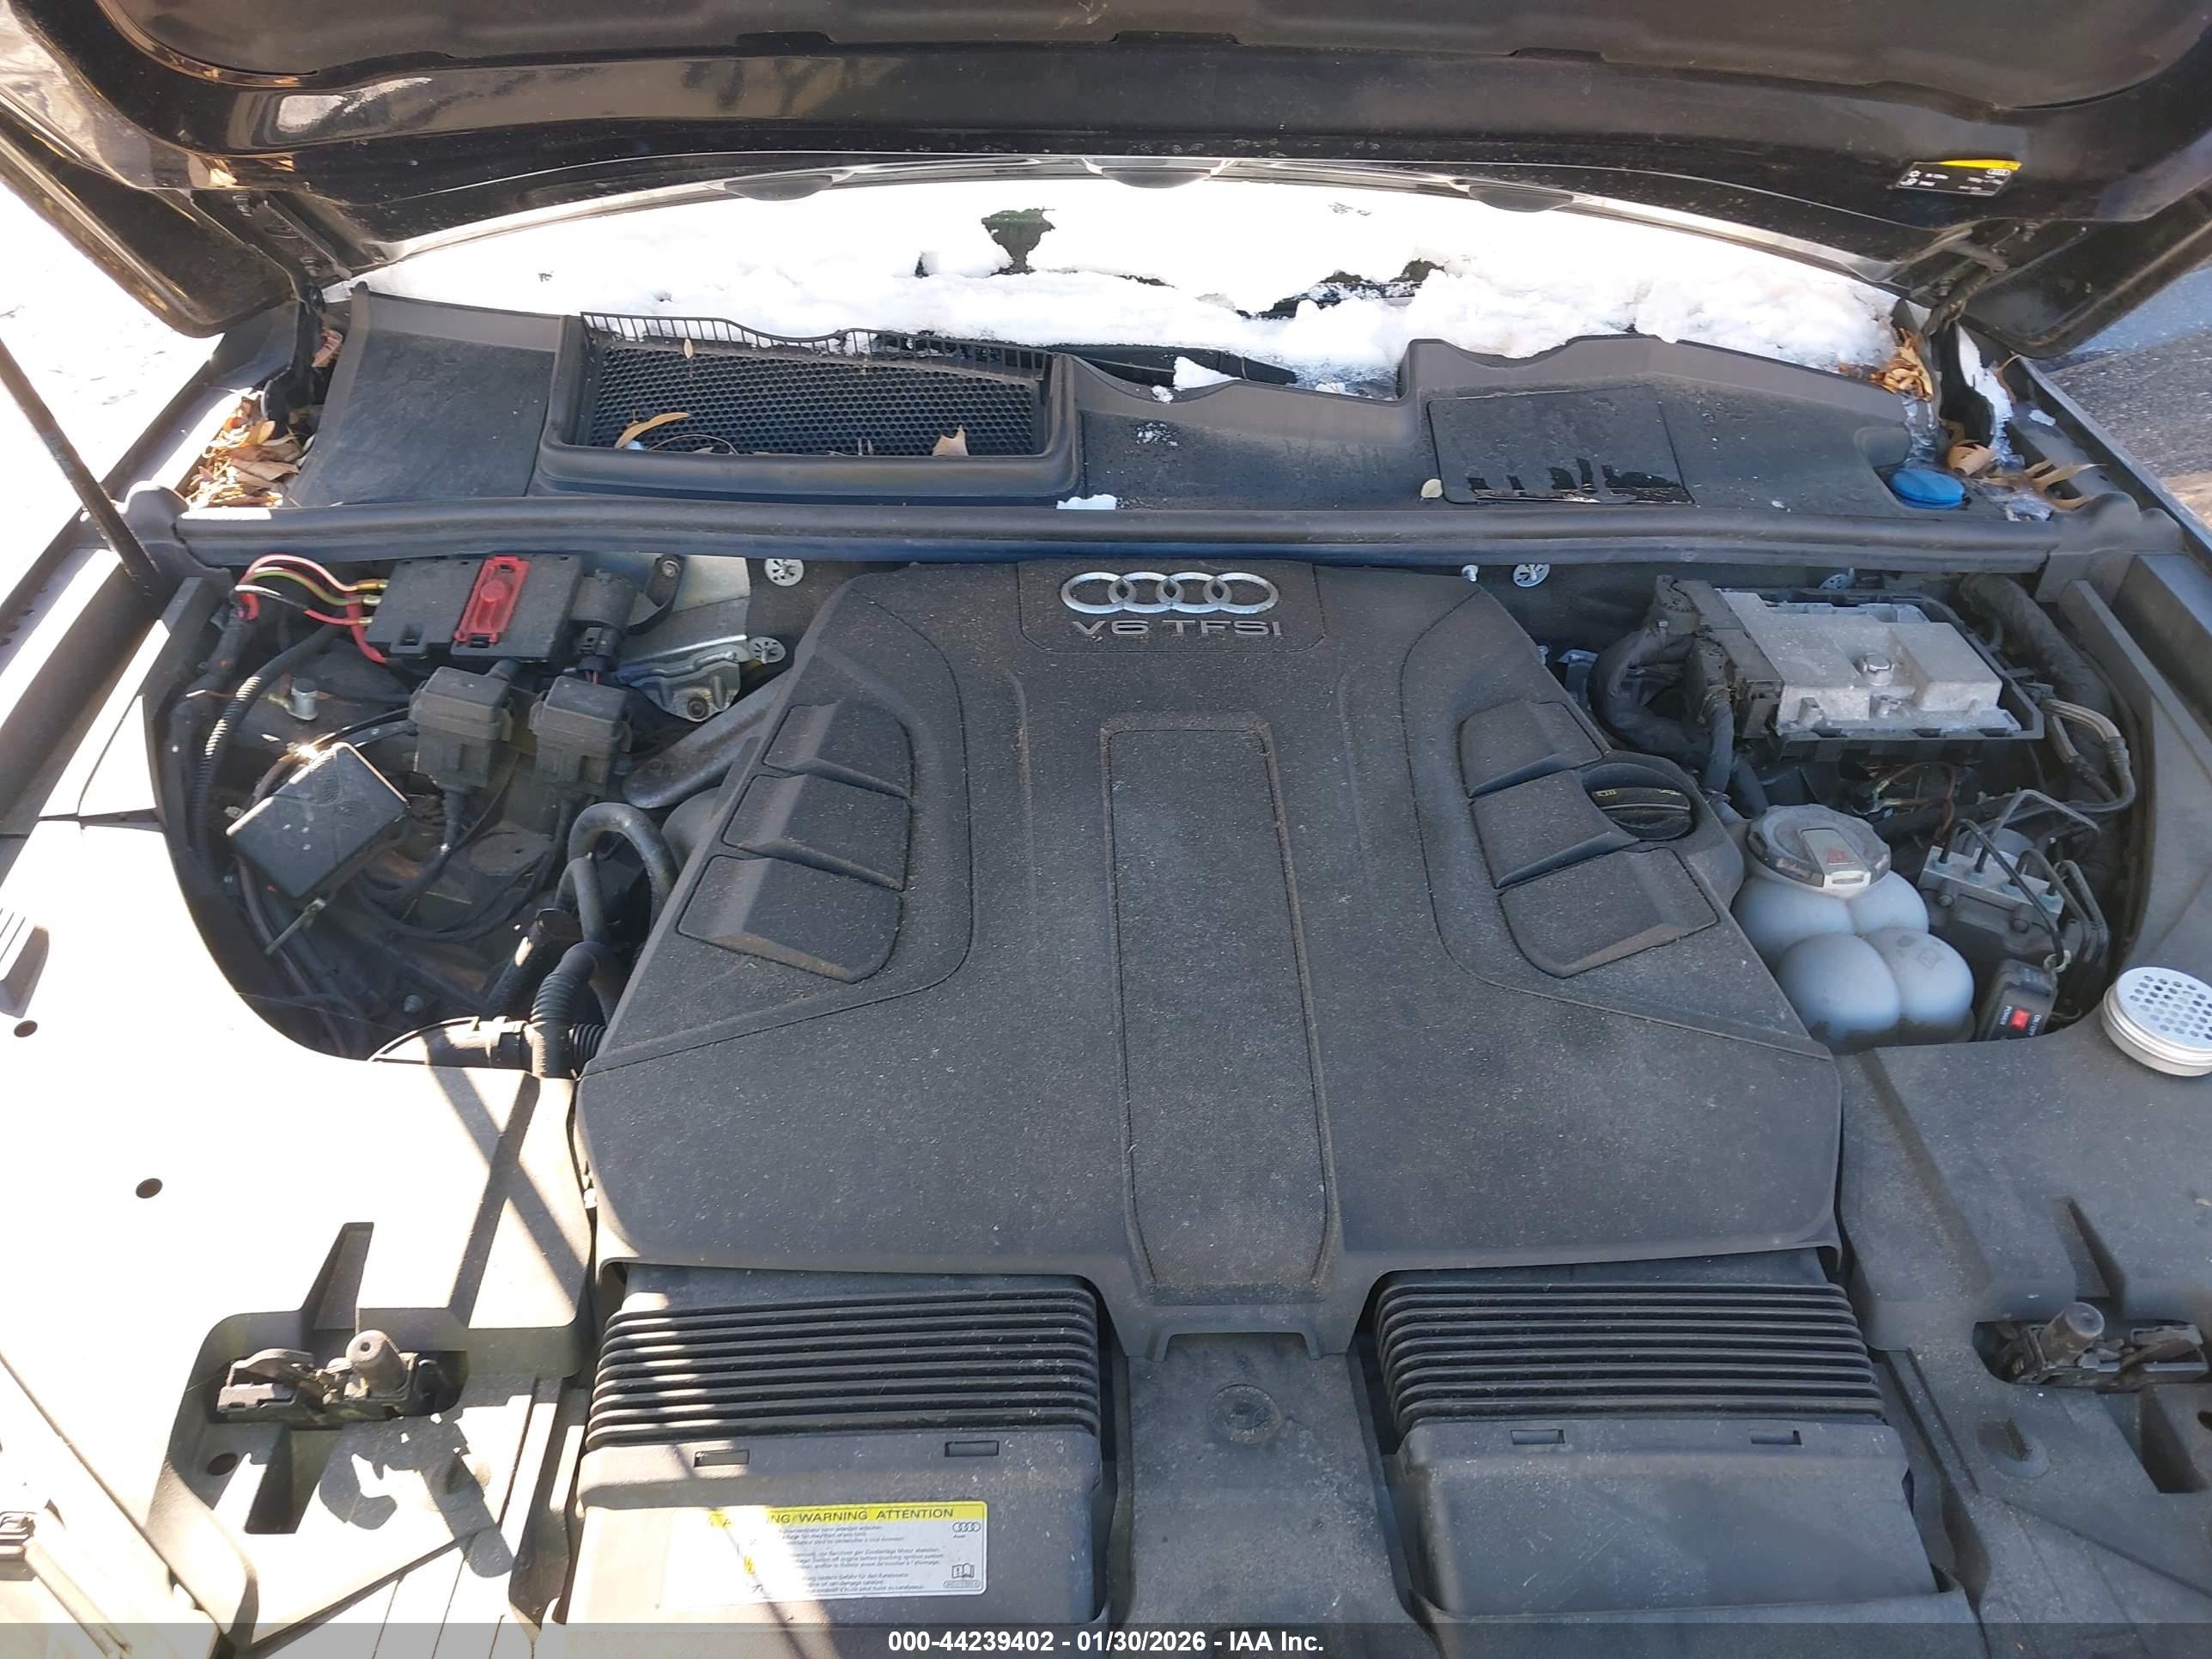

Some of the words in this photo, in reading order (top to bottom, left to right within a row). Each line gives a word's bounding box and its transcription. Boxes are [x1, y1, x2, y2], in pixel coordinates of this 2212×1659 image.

[1072, 620, 1149, 635] V6
[1162, 620, 1282, 635] TFSI
[799, 1510, 868, 1522] WARNING
[876, 1509, 953, 1521] ATTENTION
